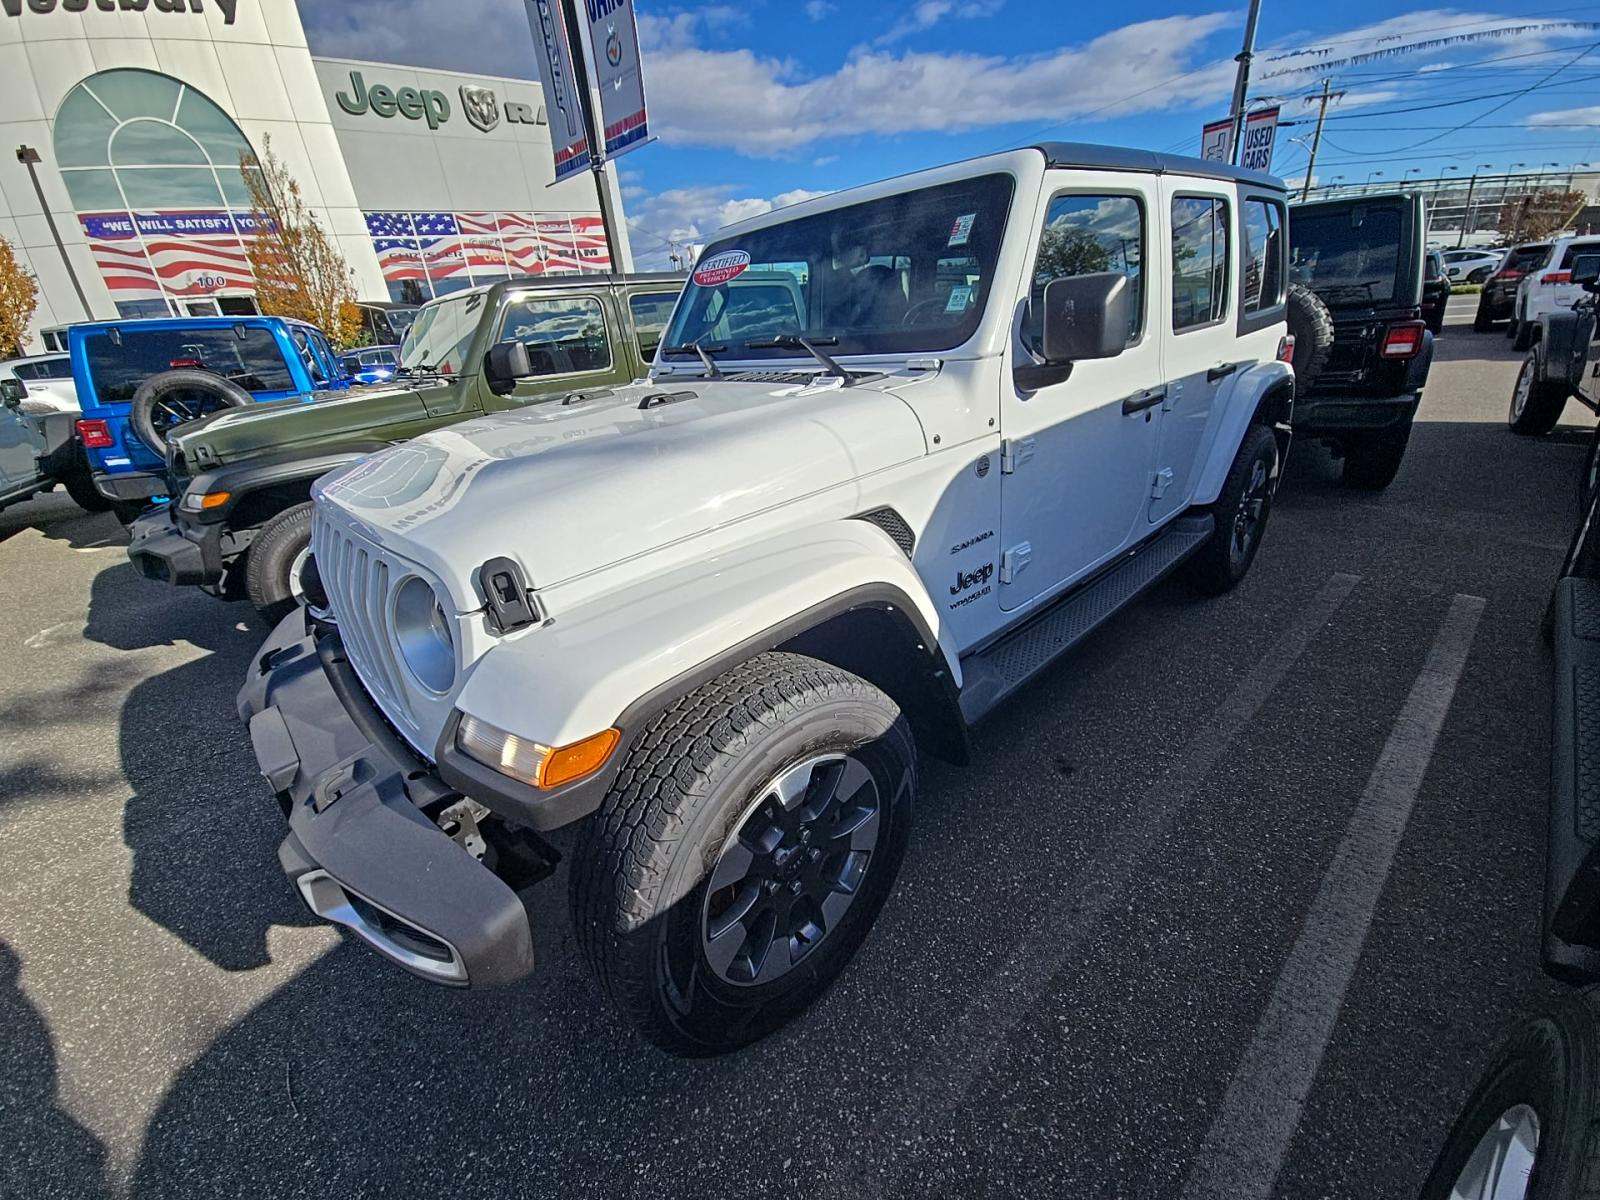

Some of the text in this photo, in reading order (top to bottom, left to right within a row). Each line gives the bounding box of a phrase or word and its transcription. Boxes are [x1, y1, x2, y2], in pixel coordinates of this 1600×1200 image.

[336, 71, 451, 130] Jeep
[1246, 126, 1273, 149] USED
[1244, 148, 1269, 170] CARS
[139, 219, 173, 230] WILL
[176, 217, 230, 229] SATISFY
[700, 254, 746, 271] CERTIFIED
[196, 276, 226, 288] 100
[950, 530, 995, 555] SAHARA
[950, 562, 994, 595] Jeep
[950, 585, 991, 610] WRANGLER
